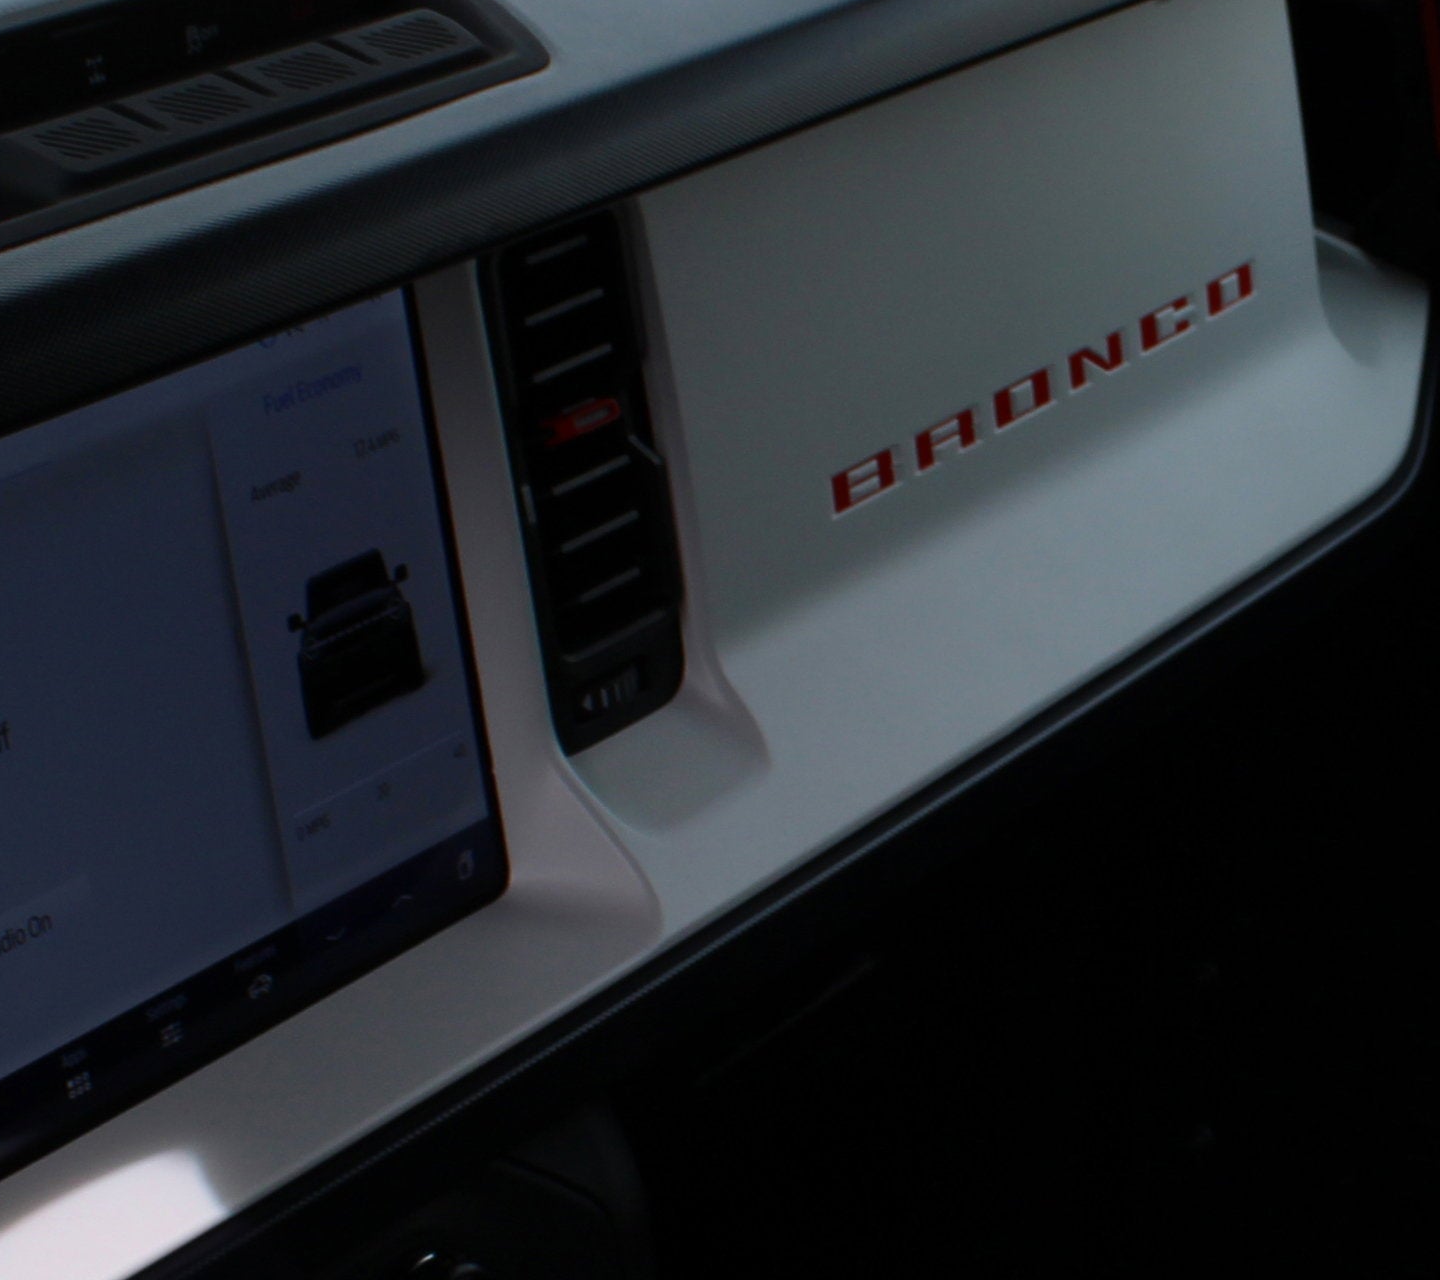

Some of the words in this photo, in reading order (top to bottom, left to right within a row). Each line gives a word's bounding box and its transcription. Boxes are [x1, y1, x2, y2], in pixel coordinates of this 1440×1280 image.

[263, 392, 297, 416] Fuel
[298, 365, 362, 401] Economy
[831, 262, 1256, 519] BRONCO
[27, 915, 53, 938] On
